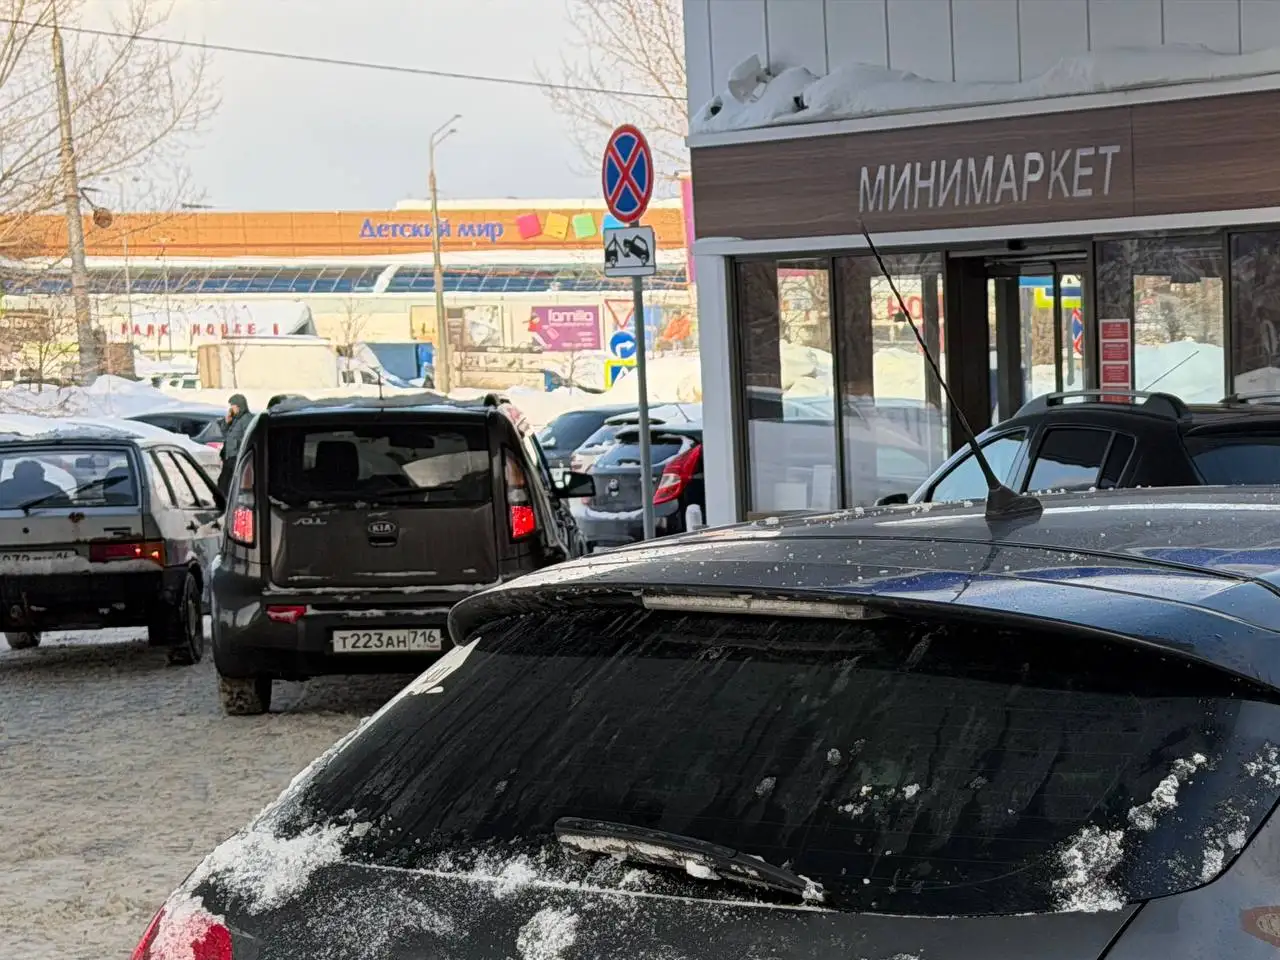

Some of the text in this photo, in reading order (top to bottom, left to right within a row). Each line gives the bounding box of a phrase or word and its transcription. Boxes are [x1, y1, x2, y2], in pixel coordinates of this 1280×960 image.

[859, 145, 1121, 212] МИНИМАРКЕТ
[359, 218, 504, 244] Детский мир
[371, 523, 392, 533] KIA
[339, 630, 436, 649] Т223АН 716
